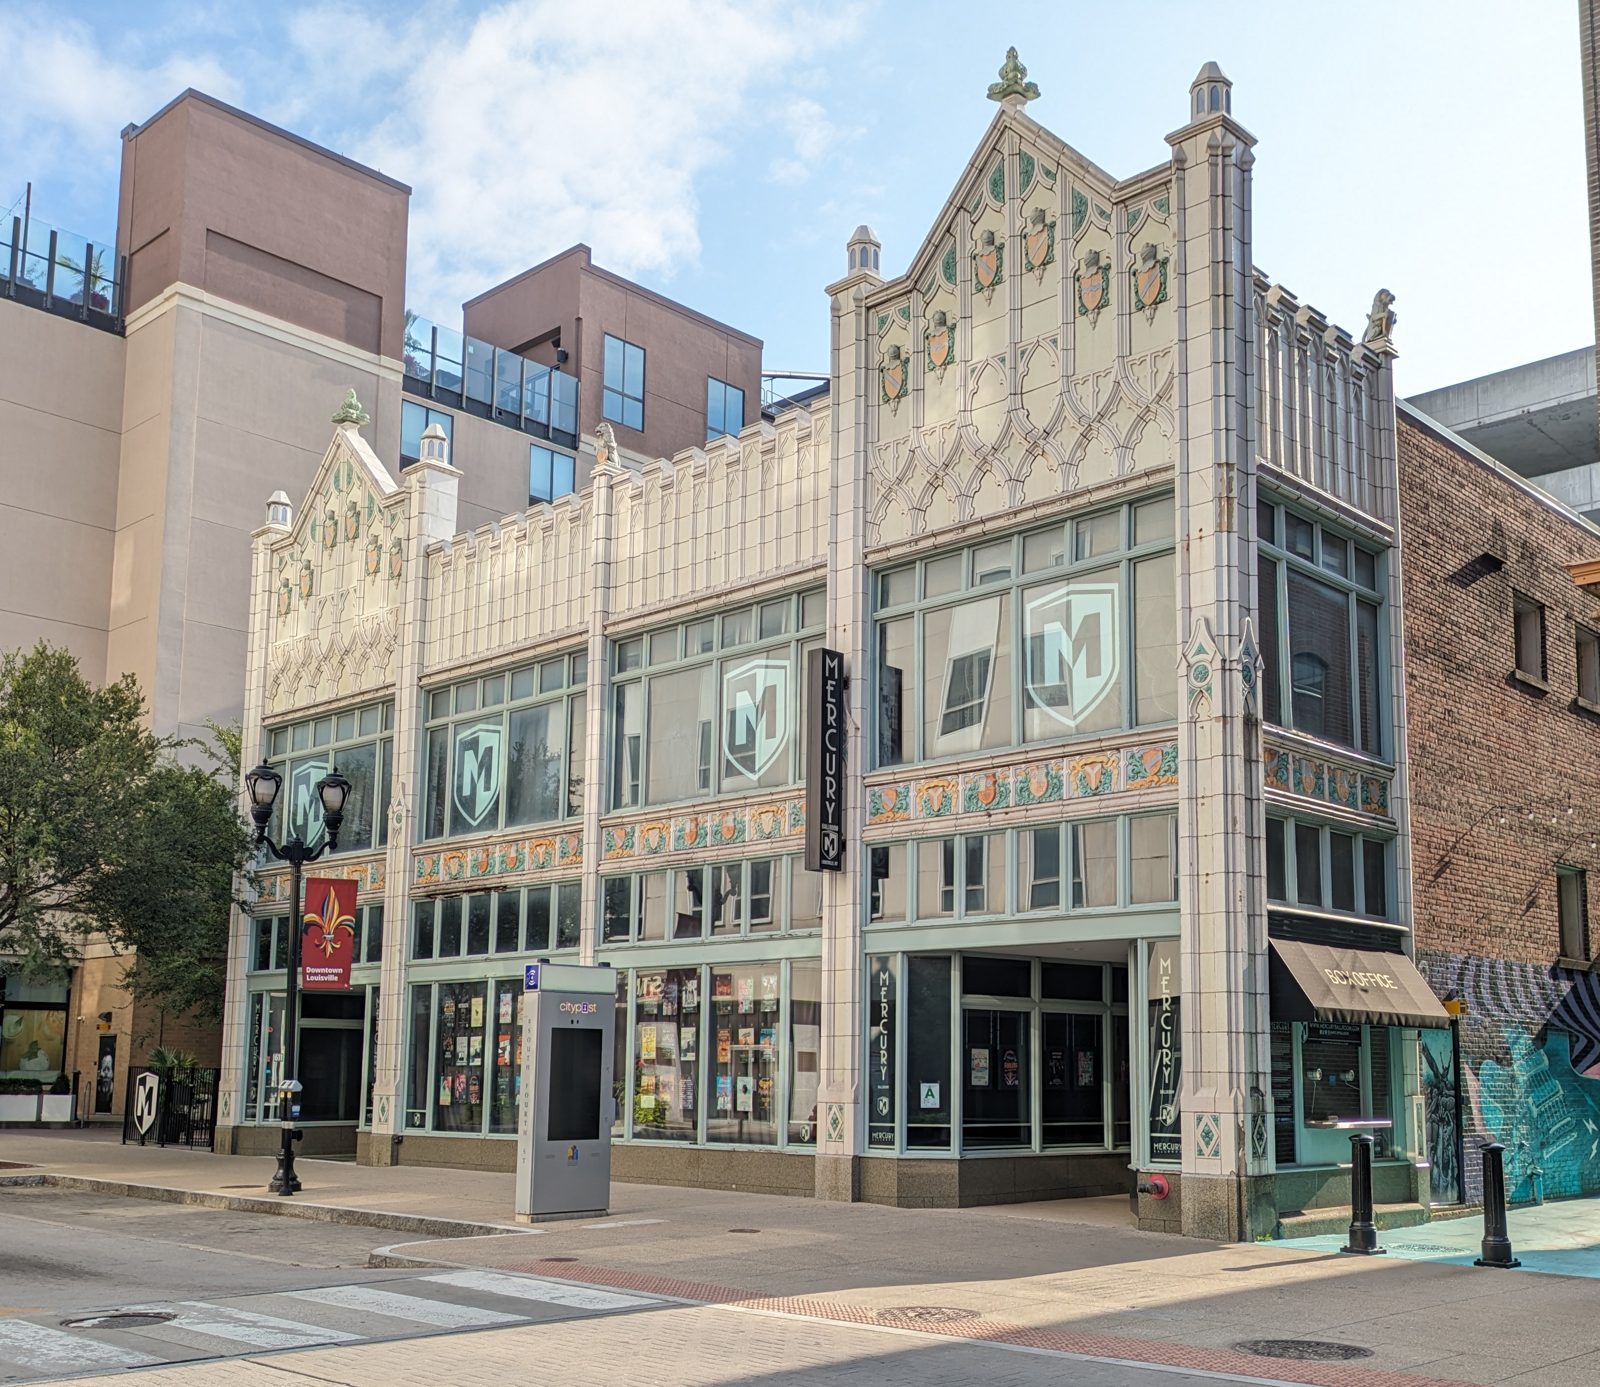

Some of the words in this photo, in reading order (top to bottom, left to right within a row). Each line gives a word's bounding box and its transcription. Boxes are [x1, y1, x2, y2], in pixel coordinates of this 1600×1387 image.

[1044, 611, 1102, 688] M
[735, 683, 777, 746] M
[825, 655, 838, 823] MERCURY
[462, 745, 494, 797] M
[1324, 968, 1354, 986] BOX
[1352, 970, 1398, 990] OFFICE
[880, 971, 889, 1080] MERCURY
[1159, 957, 1172, 1084] MERCURY
[924, 1087, 935, 1099] A
[1153, 1142, 1182, 1151] MERCURY
